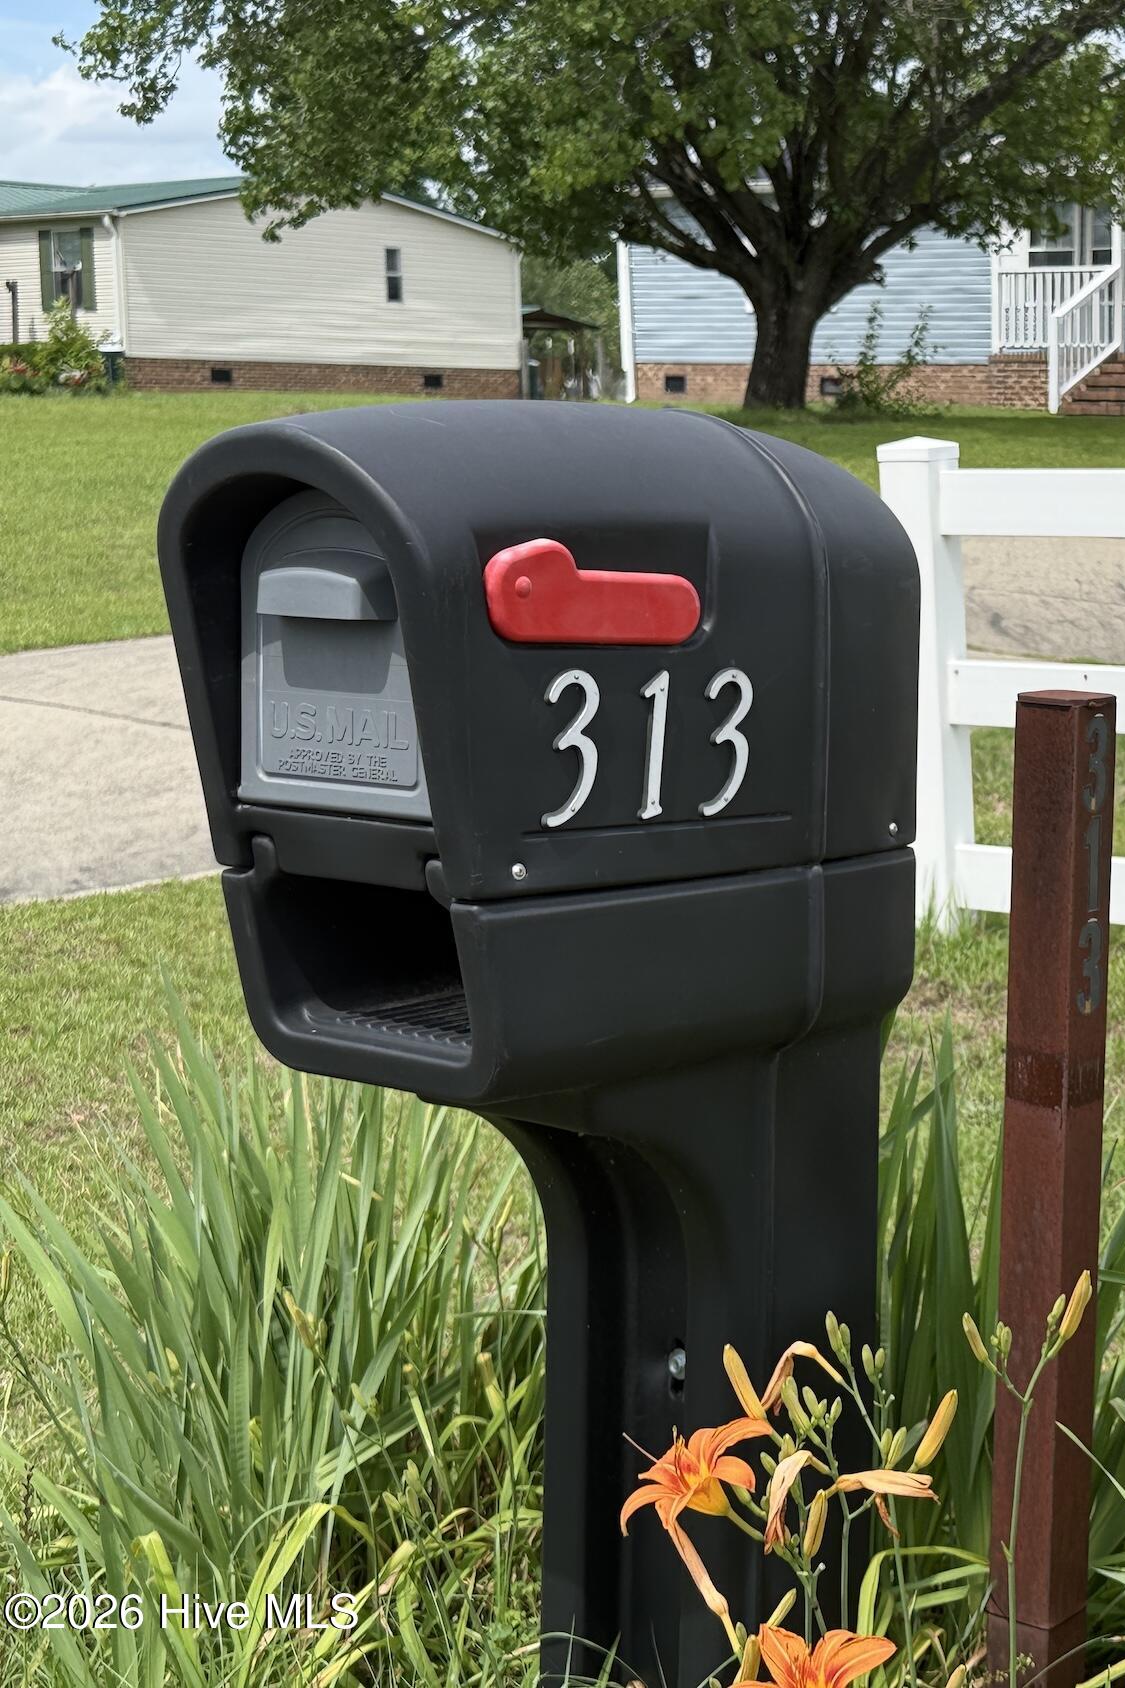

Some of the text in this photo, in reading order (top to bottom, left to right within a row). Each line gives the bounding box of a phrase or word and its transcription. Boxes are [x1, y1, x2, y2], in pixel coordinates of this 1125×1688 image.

[270, 701, 409, 750] U.S. MAIL
[540, 668, 754, 827] 313
[278, 759, 398, 782] POSTMASTER GENERAL
[289, 748, 387, 768] APPROVED BY THE
[1076, 713, 1109, 1016] 313
